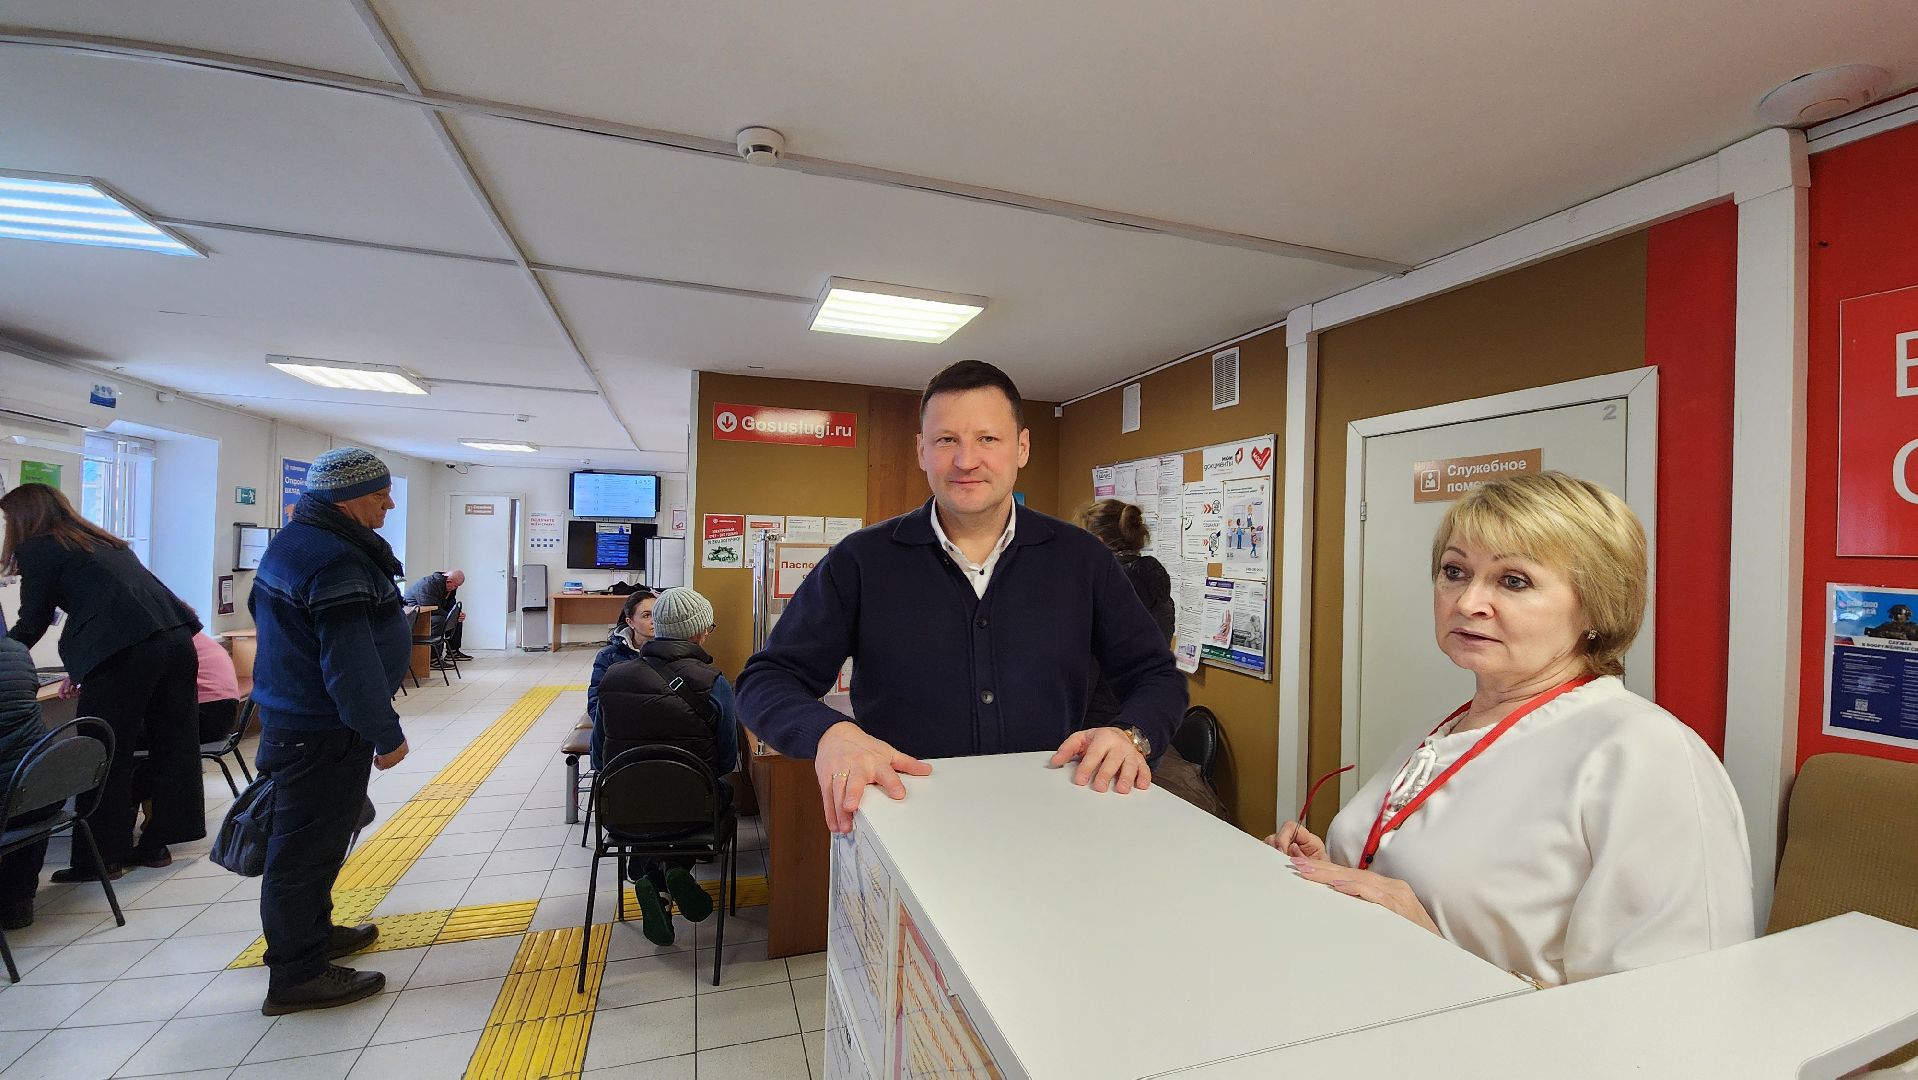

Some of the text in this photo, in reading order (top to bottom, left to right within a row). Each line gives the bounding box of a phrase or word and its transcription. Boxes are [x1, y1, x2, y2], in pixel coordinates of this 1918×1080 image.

[742, 416, 852, 438] Gosuslugi.ru
[1447, 459, 1527, 477] Служебное
[781, 561, 818, 569] Паспо
